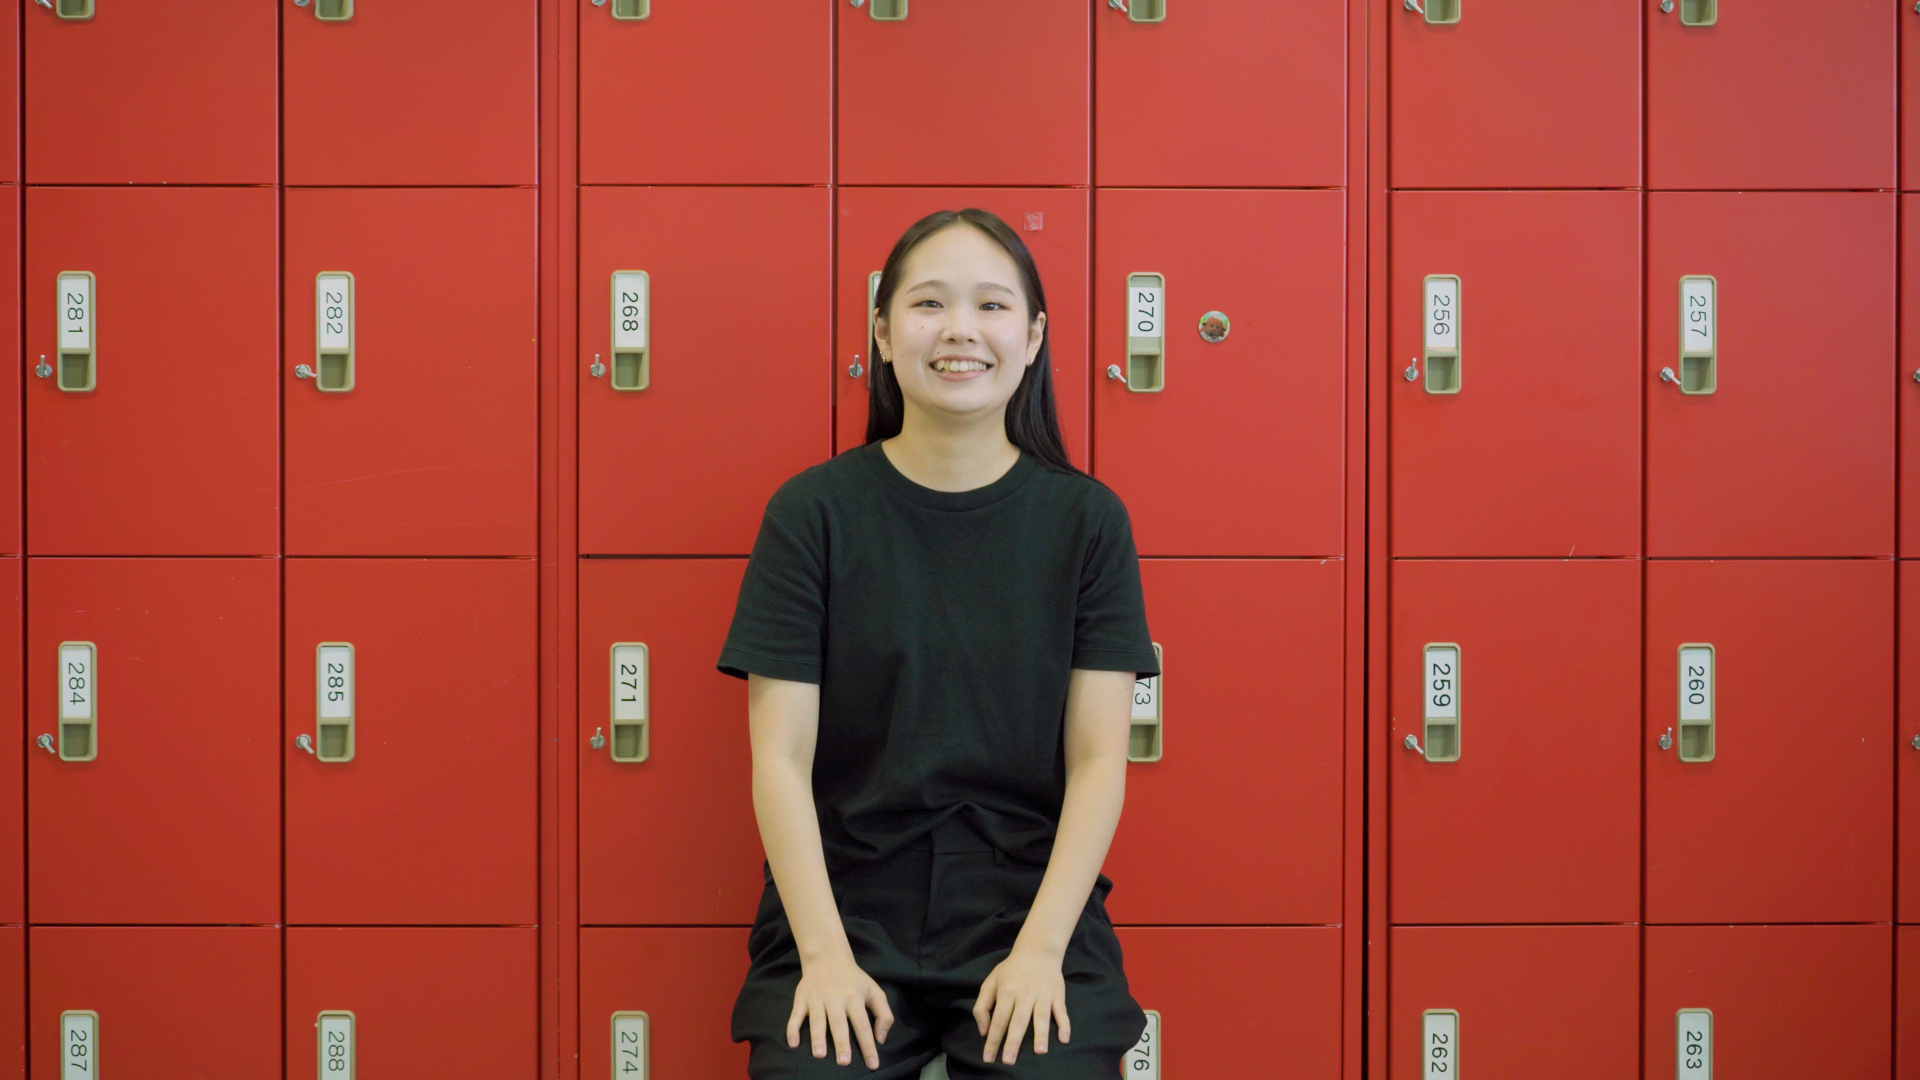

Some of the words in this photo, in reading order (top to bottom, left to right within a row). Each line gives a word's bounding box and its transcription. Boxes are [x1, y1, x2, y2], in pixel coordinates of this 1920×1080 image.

[67, 292, 84, 333] 281
[326, 291, 343, 334] 282
[622, 291, 639, 332] 268
[1137, 292, 1155, 332] 270
[1433, 294, 1450, 335] 256
[1690, 295, 1707, 337] 257
[68, 662, 86, 705] 284
[327, 662, 344, 702] 285
[621, 664, 638, 702] 271
[1134, 677, 1151, 705] 73
[1432, 663, 1451, 707] 259
[1688, 665, 1705, 705] 260
[70, 1029, 88, 1072] 287
[328, 1030, 345, 1072] 288
[621, 1031, 639, 1074] 274
[1431, 1033, 1449, 1073] 262
[1685, 1030, 1703, 1070] 263
